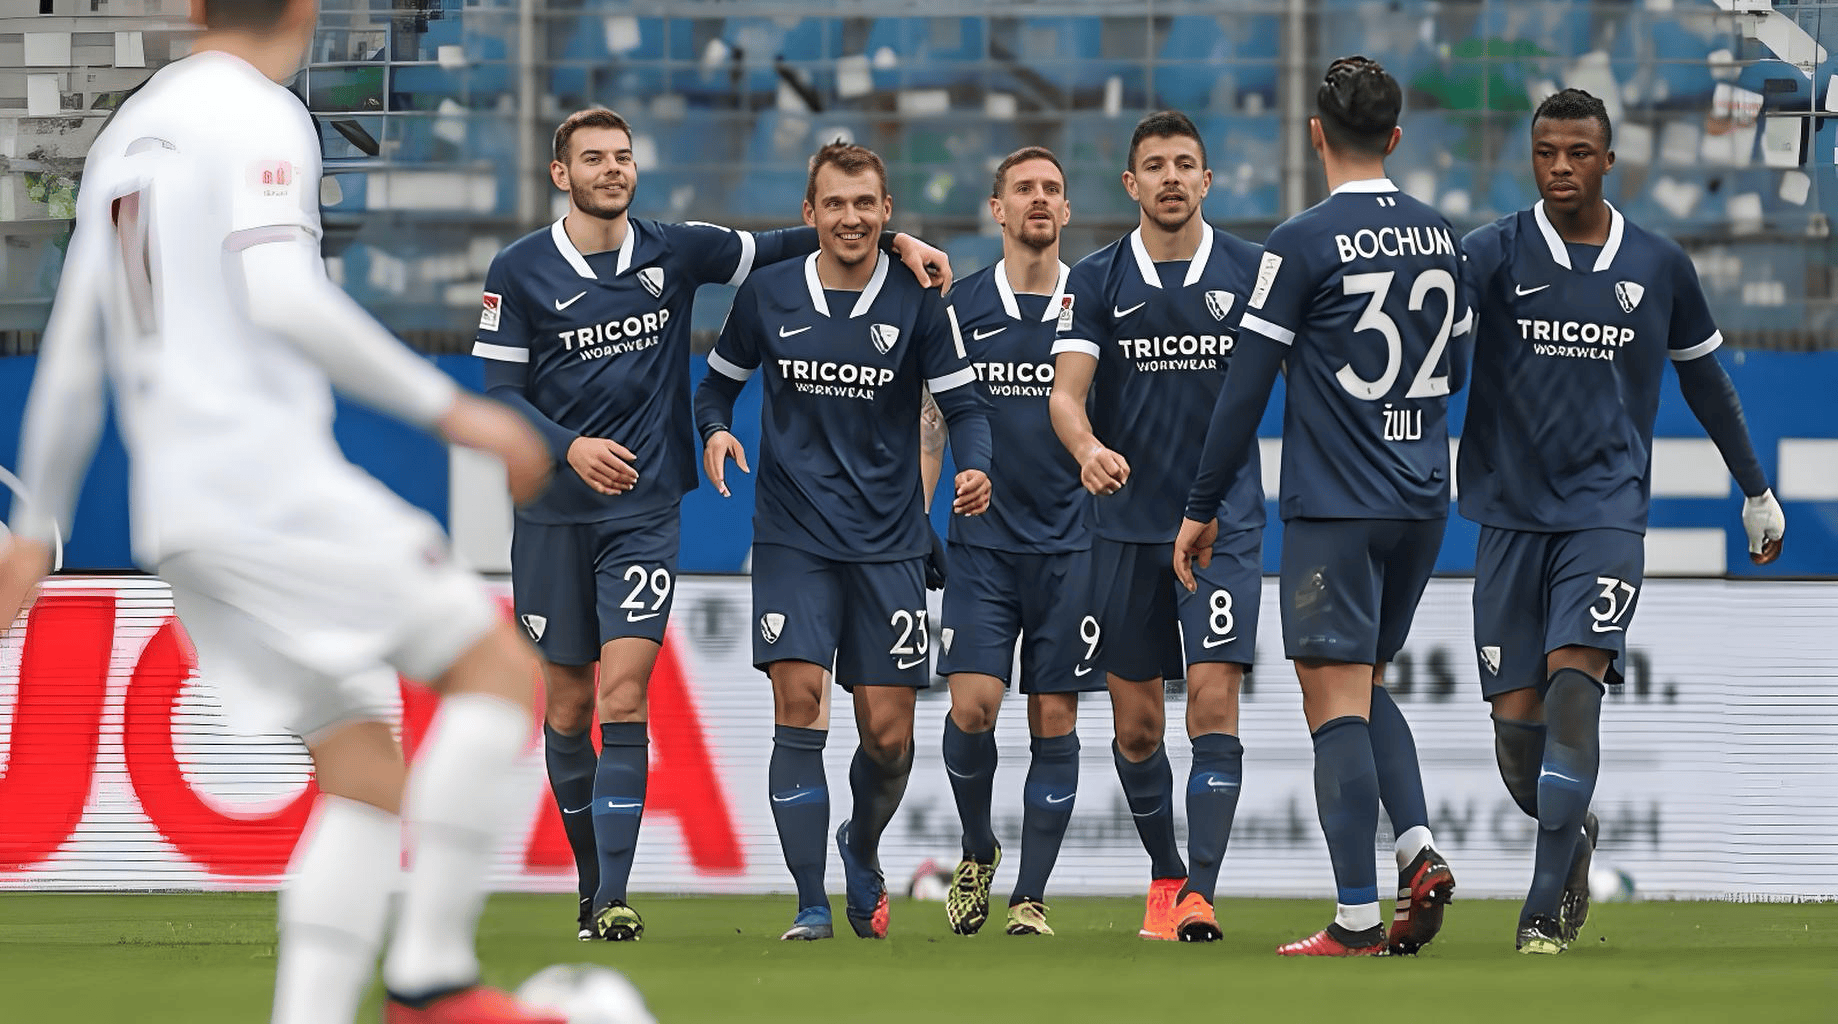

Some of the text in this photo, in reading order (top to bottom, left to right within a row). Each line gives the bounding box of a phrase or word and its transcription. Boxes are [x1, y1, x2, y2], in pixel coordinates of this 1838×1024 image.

[1334, 226, 1456, 263] BOCHUM
[558, 307, 670, 351] TRICORP
[1118, 335, 1234, 359] TRICORP
[1335, 268, 1456, 401] 32
[1516, 318, 1635, 347] TRICORP
[778, 359, 895, 387] TRICORP
[972, 362, 1055, 383] TRICO
[619, 564, 671, 612] 29
[1589, 576, 1637, 624] 37
[889, 608, 929, 656] 23
[1209, 589, 1234, 636] 8
[1079, 615, 1101, 661] 9
